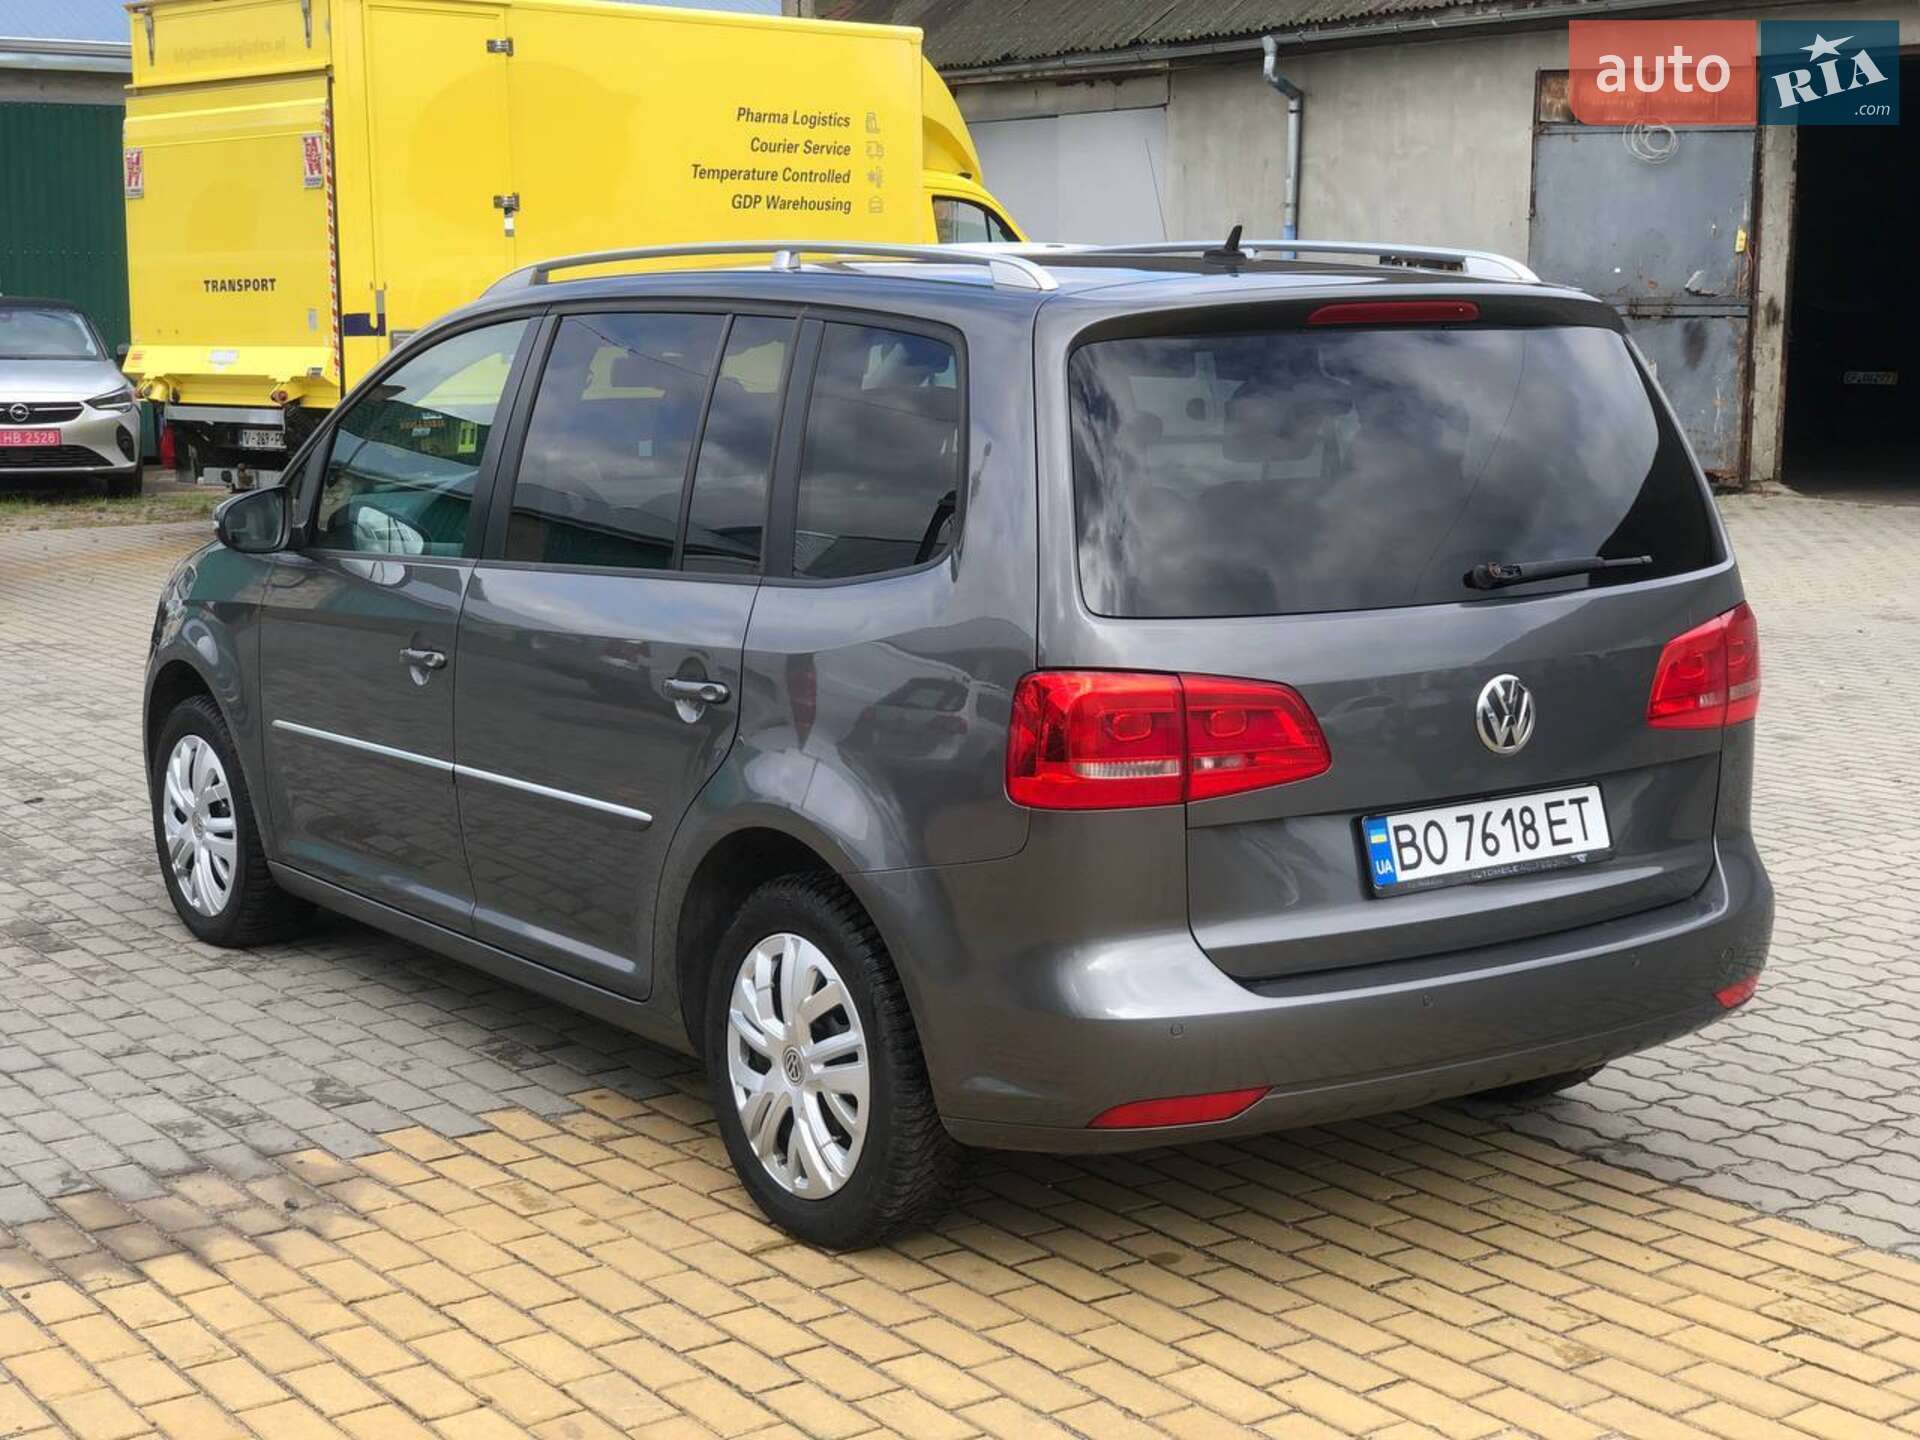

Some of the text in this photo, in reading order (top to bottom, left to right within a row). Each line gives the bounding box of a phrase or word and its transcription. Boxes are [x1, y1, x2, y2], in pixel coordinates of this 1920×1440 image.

[736, 107, 851, 129] Pharma Logistics
[750, 137, 852, 156] Courier Service
[691, 163, 851, 184] Temperature Controlled
[731, 193, 852, 215] GDP Warehousing
[203, 278, 277, 293] TRANSPORT
[3, 431, 22, 444] HB
[1393, 819, 1449, 872] BO
[1455, 804, 1540, 862] 7618
[1545, 796, 1590, 847] ET
[1376, 859, 1394, 876] UA
